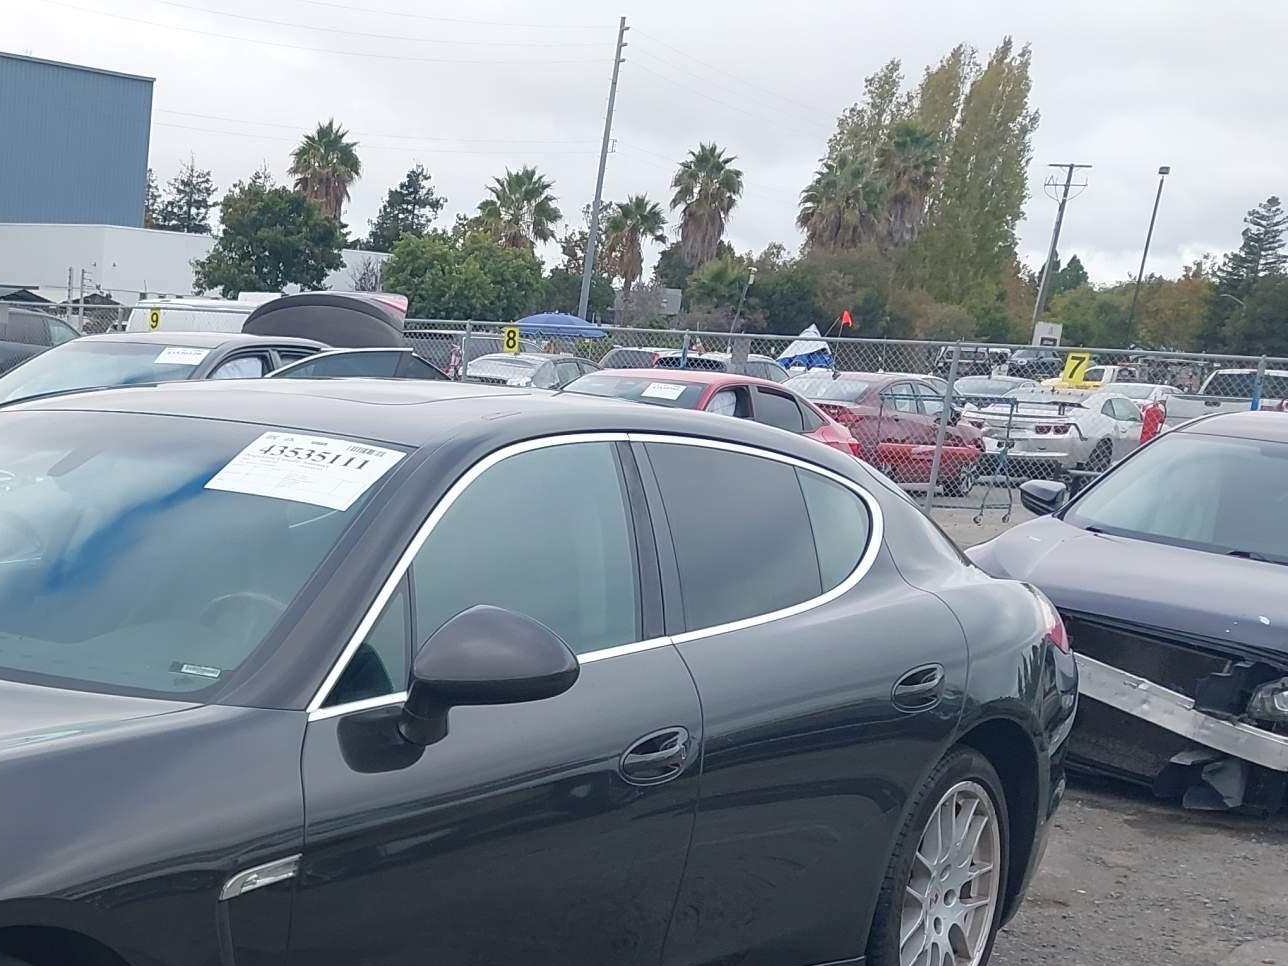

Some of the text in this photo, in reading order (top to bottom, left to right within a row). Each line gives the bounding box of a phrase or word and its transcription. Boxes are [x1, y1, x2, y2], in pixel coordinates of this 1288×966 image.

[150, 312, 159, 329] 9
[506, 329, 517, 349] 8
[1068, 355, 1087, 379] 7
[259, 444, 370, 470] 43535111
